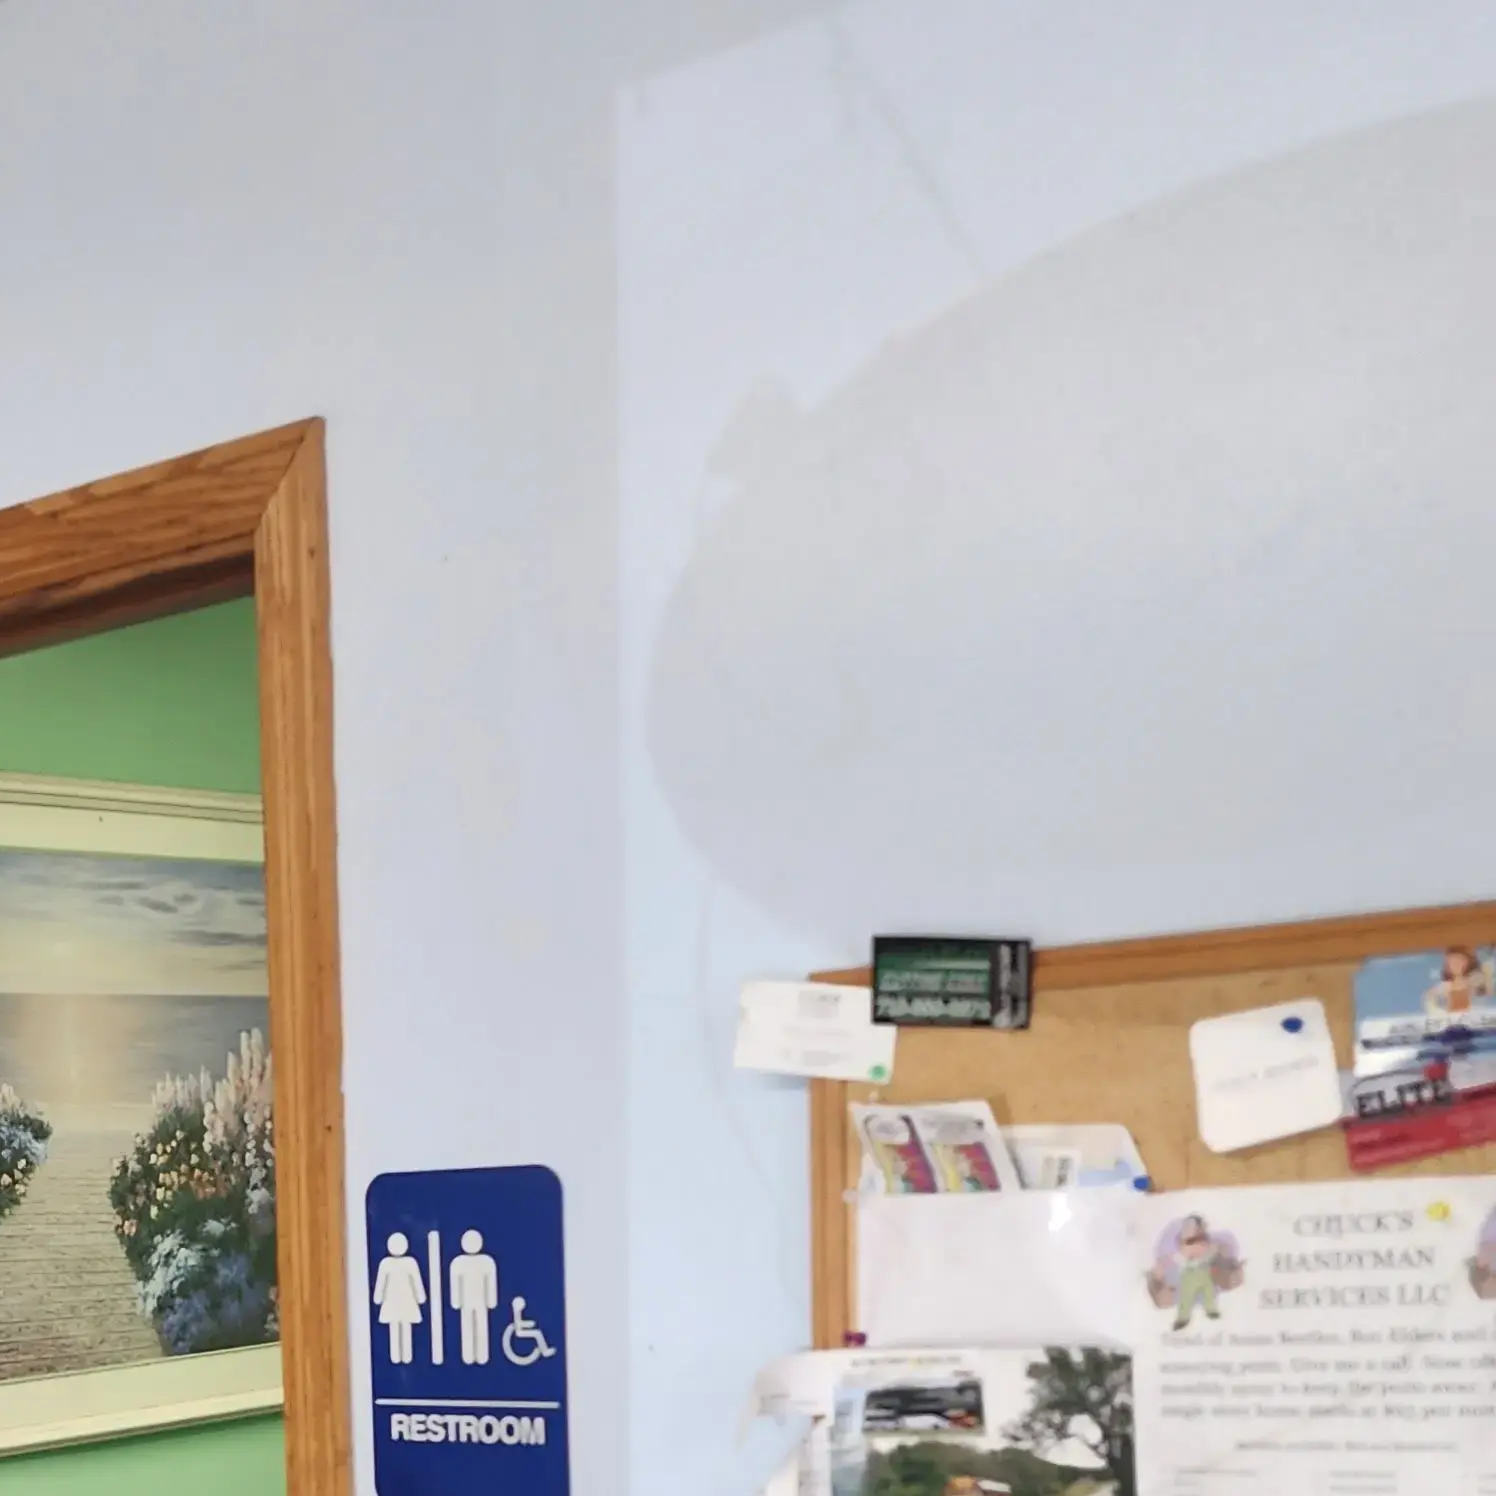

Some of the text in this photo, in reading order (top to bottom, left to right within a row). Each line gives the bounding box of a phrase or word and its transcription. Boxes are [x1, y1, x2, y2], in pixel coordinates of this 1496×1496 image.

[1292, 1210, 1414, 1238] CHUCK'S
[1272, 1247, 1436, 1273] HANDYMAN
[1258, 1283, 1450, 1310] SERVICES LLC
[390, 1413, 546, 1446] RESTROOM
